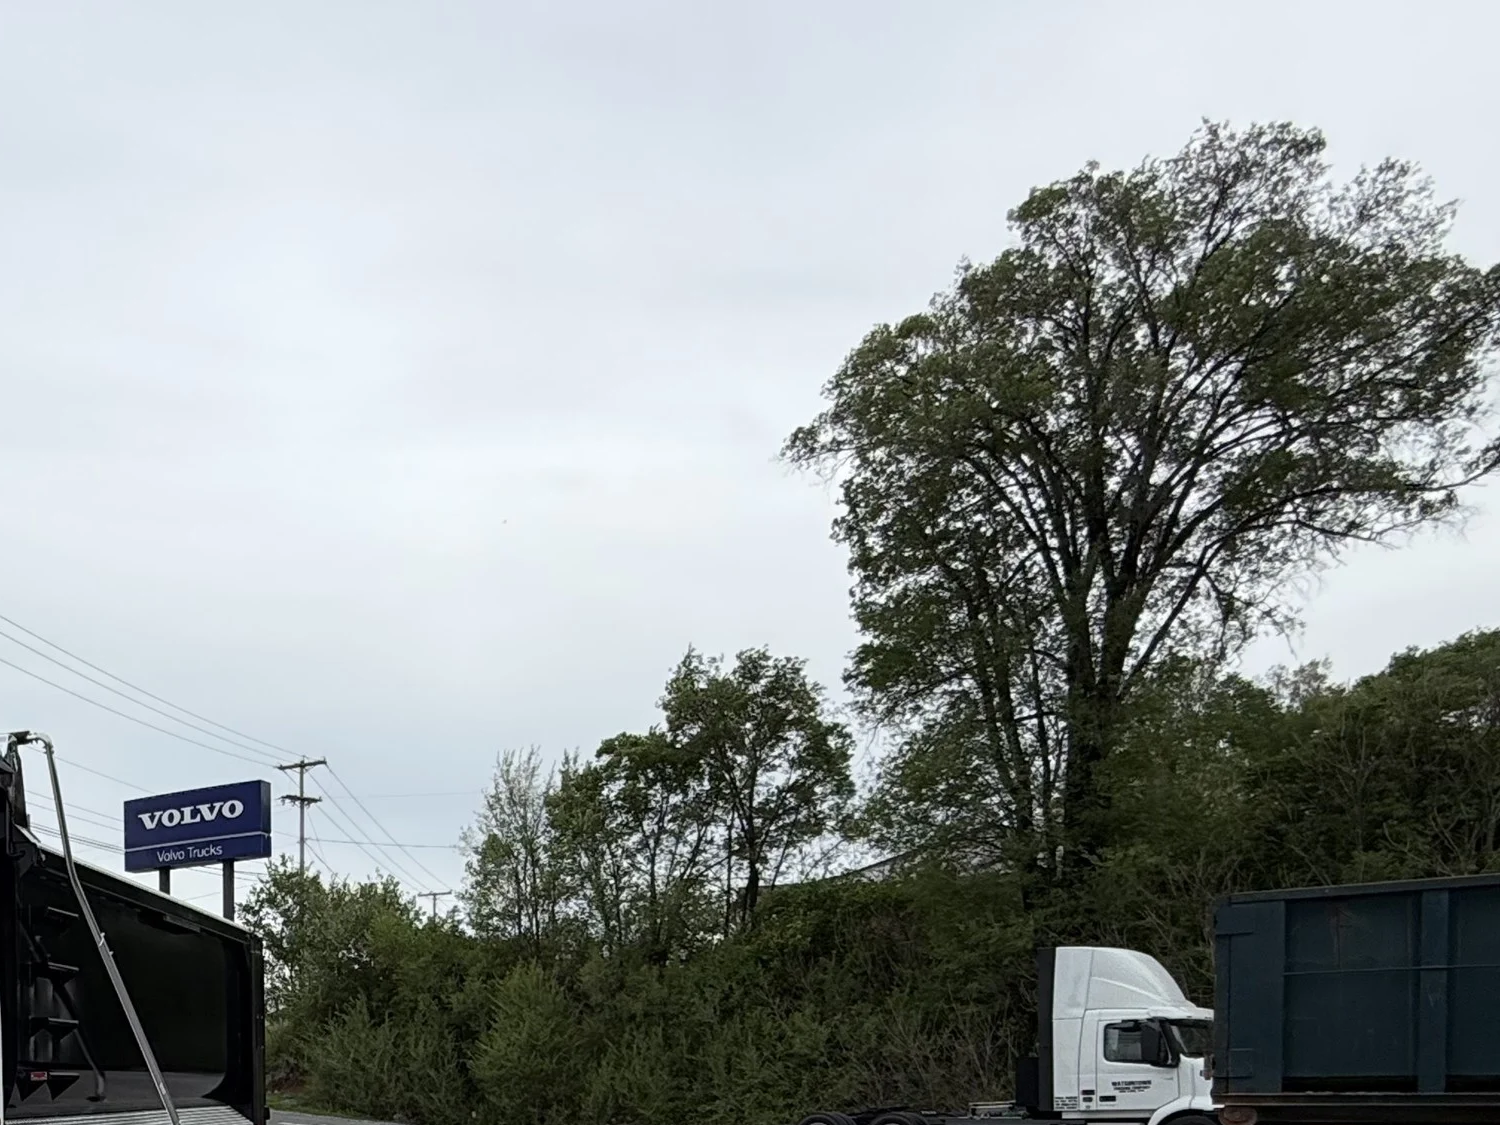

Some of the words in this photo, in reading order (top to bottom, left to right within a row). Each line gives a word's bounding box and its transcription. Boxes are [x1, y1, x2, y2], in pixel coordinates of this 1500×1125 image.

[138, 800, 244, 830] VOLVO
[157, 850, 185, 862] Volvo
[187, 844, 223, 859] Trucks
